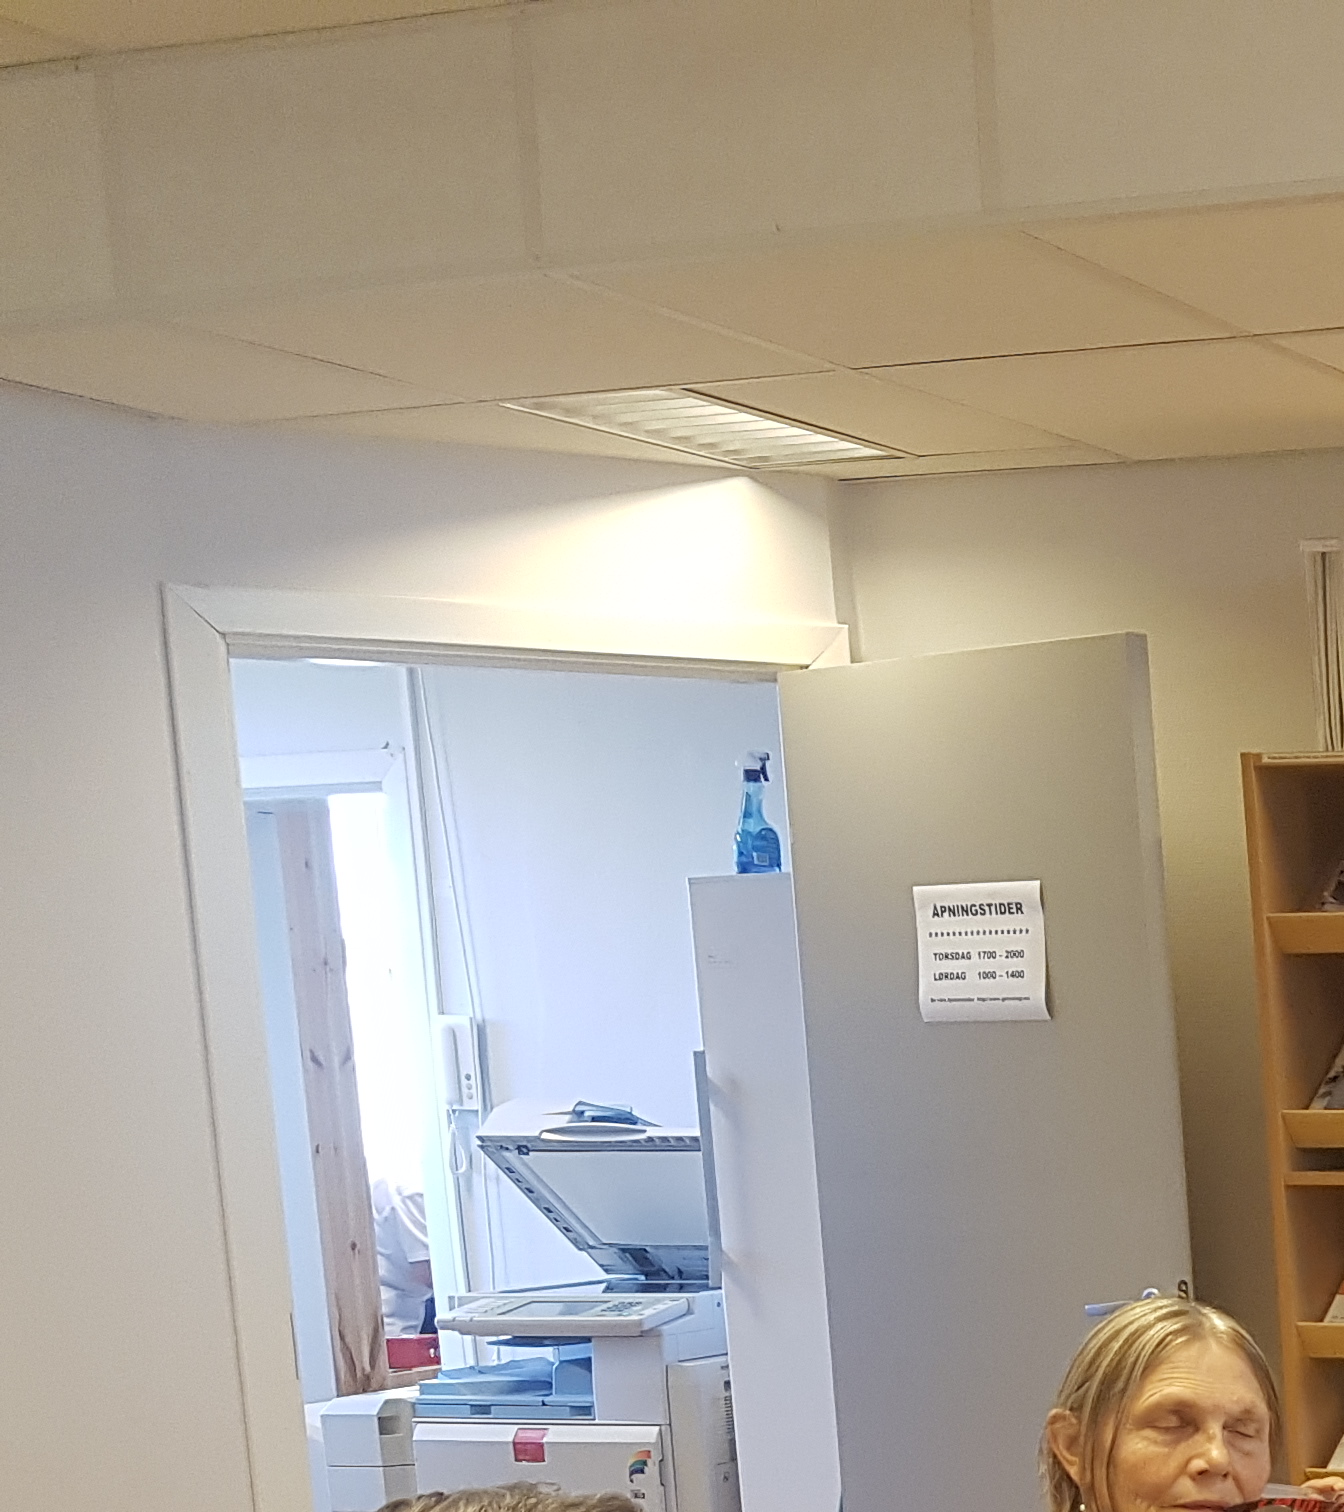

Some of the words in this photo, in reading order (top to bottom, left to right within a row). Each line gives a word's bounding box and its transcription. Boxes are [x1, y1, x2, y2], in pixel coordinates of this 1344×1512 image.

[932, 902, 1024, 918] ÅPNINGSTIDER
[933, 951, 972, 961] TORSDAG
[977, 951, 997, 960] 1700
[1005, 949, 1025, 959] 2000
[1005, 970, 1025, 979] 1400
